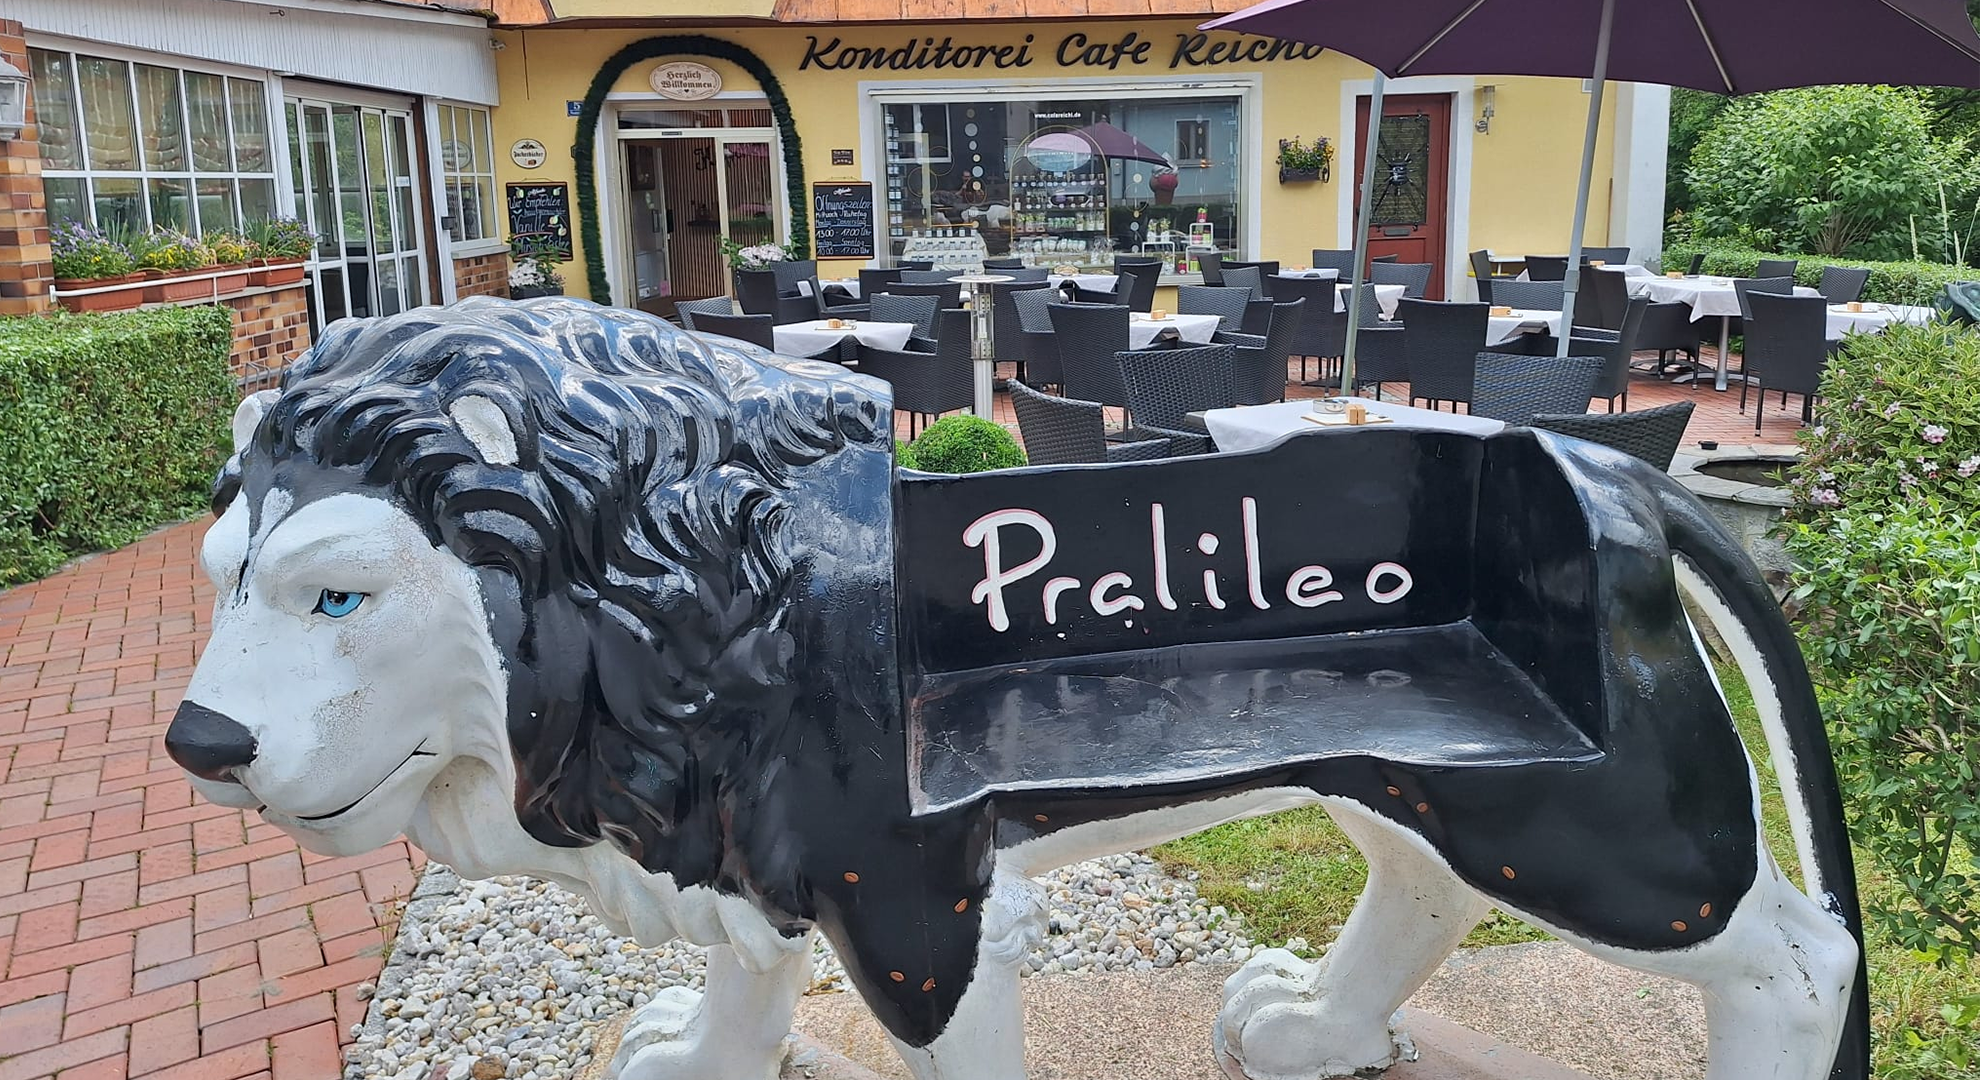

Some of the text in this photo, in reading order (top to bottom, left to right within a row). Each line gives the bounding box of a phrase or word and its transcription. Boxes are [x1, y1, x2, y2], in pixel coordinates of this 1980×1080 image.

[799, 34, 1034, 70] Konditorei
[1056, 32, 1151, 70] Cafe
[666, 70, 702, 80] Herzlich
[573, 102, 581, 110] 5
[962, 497, 1413, 632] Pralileo
